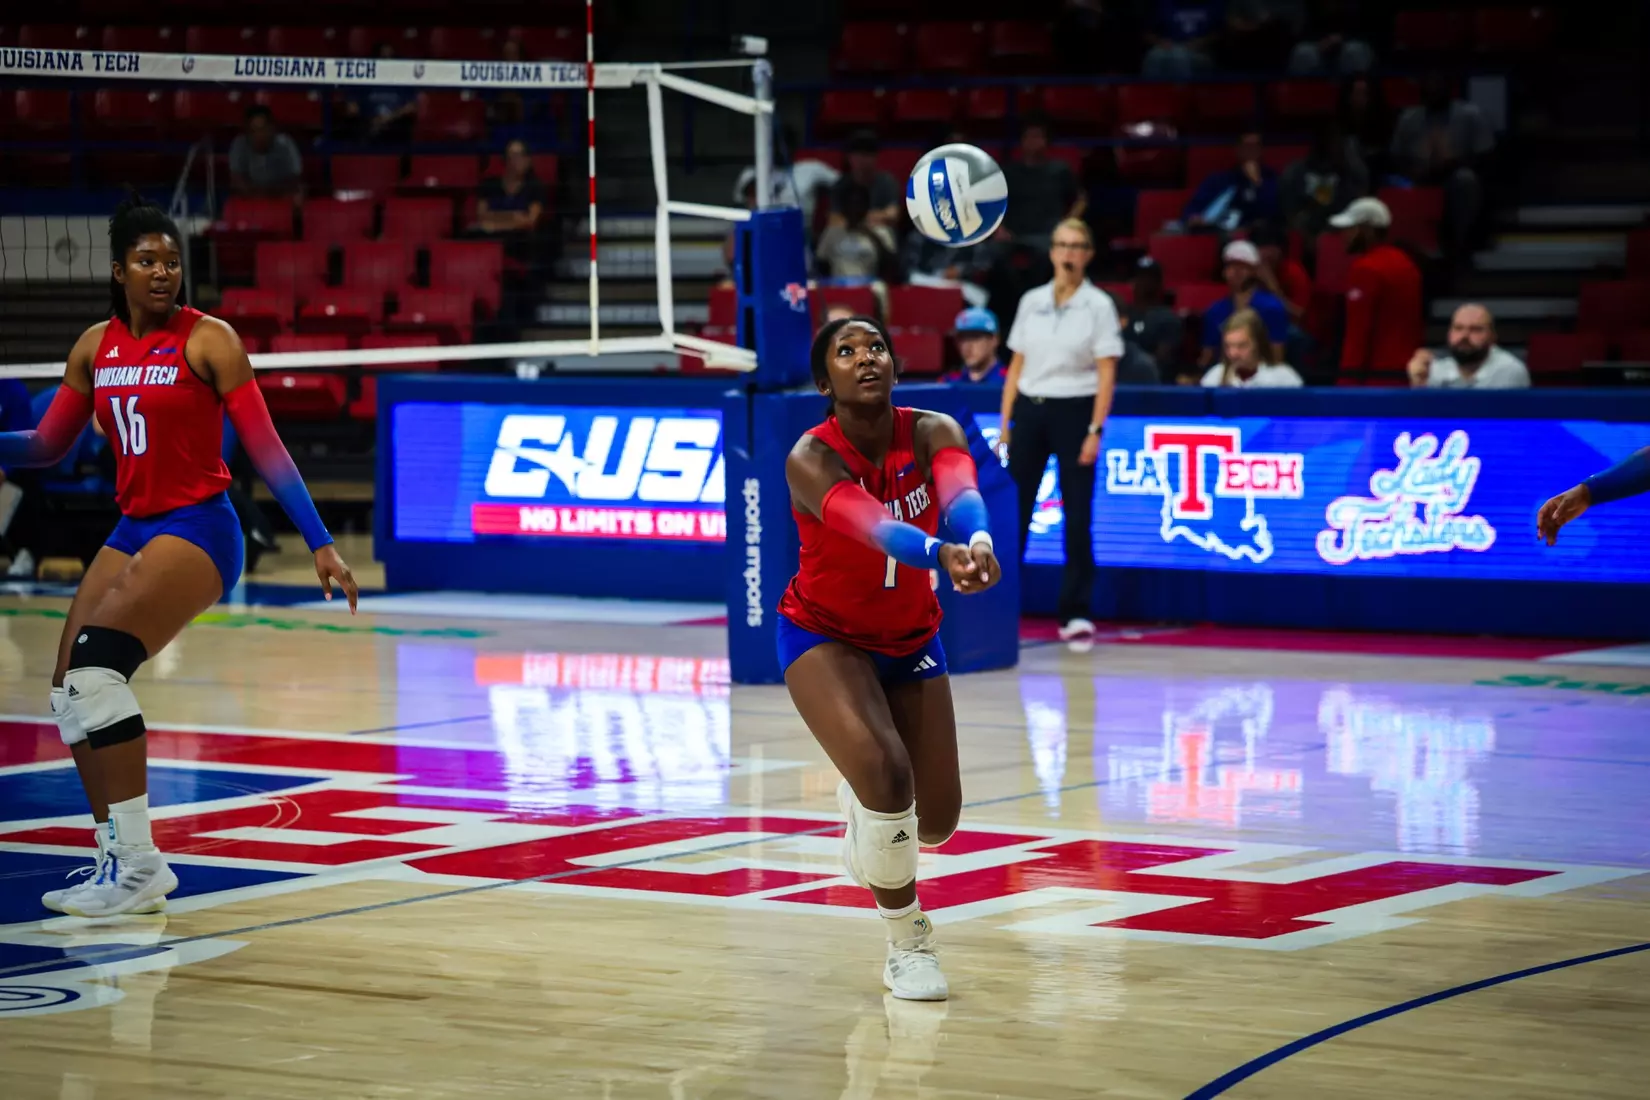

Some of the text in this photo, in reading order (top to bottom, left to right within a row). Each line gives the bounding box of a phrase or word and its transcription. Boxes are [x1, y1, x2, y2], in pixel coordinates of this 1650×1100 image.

[0, 50, 140, 73] UISIANA TECH
[234, 57, 377, 79] LOUISIANA TECH
[460, 62, 587, 82] LOUISIANA TECH
[95, 365, 179, 388] LOUISIANA TECH
[109, 395, 148, 455] 16
[1106, 449, 1166, 494] LA
[906, 483, 931, 519] TECH
[519, 507, 557, 531] NO
[560, 508, 653, 534] LIMITS
[657, 512, 694, 536] ON
[742, 478, 764, 627] sports imports
